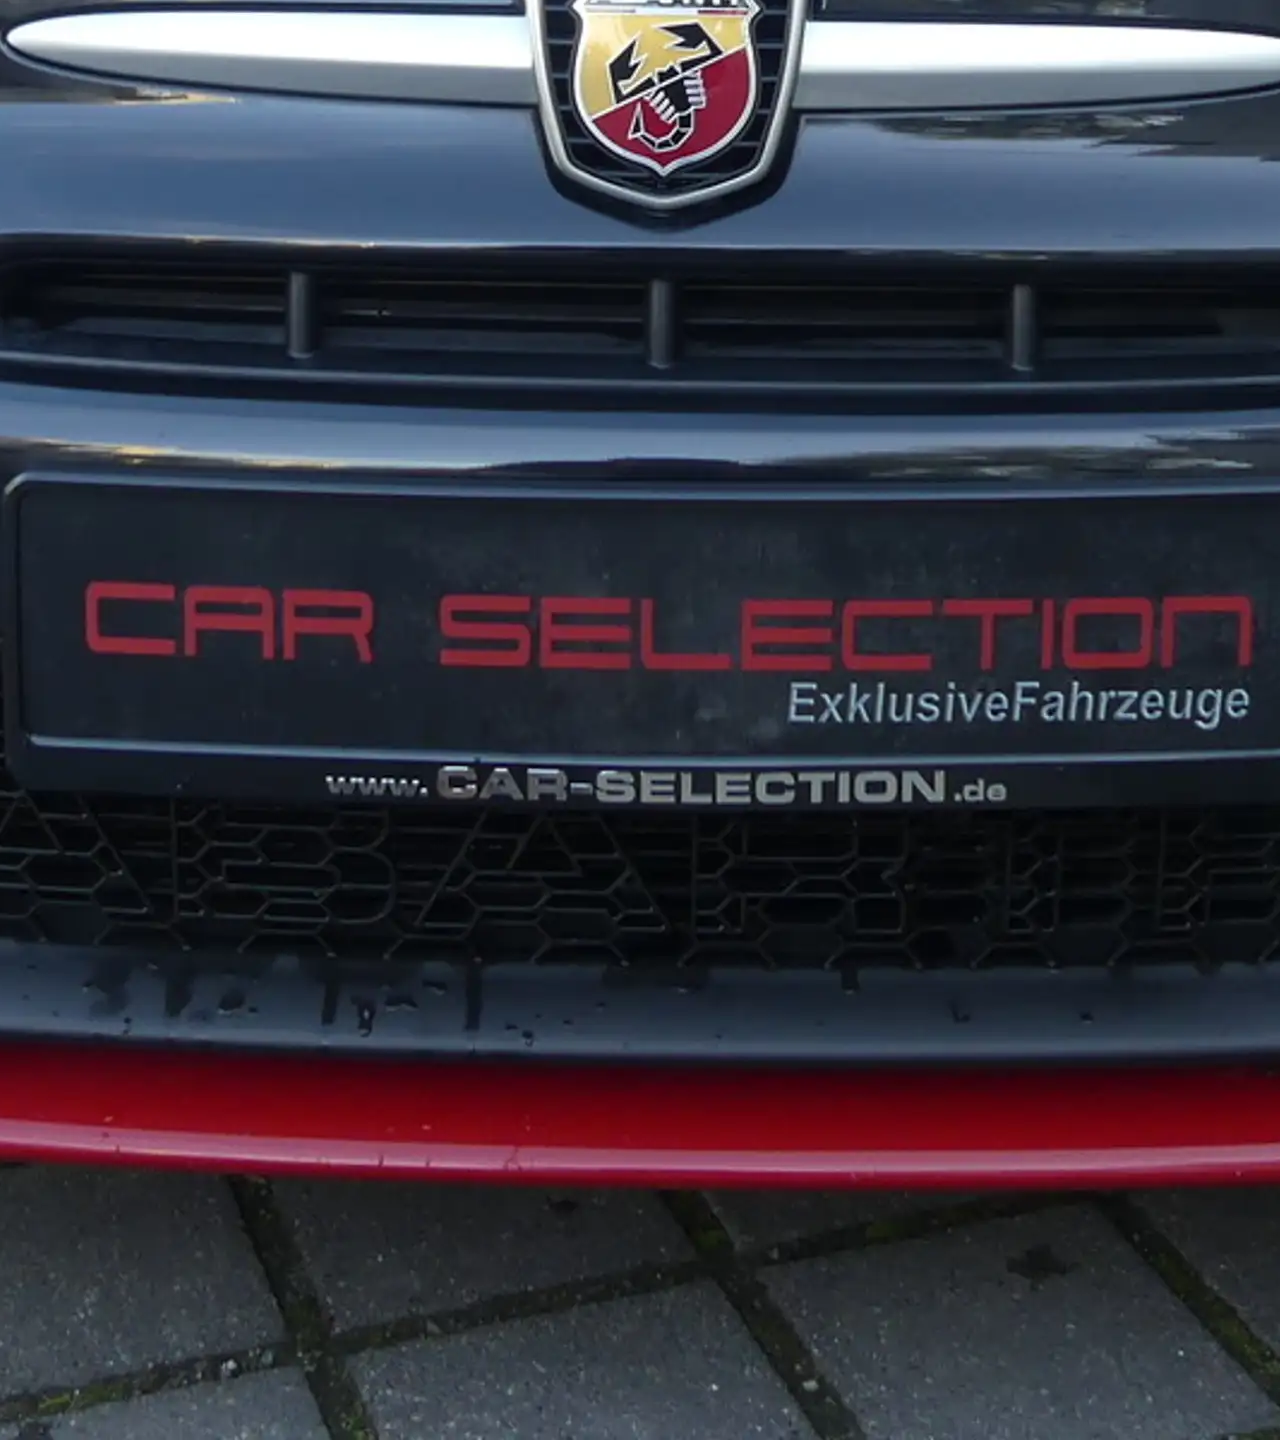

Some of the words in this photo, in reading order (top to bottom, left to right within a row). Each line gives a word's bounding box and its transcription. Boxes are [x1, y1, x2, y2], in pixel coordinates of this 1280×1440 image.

[85, 580, 374, 663] CAR
[439, 595, 1253, 671] SELECTION
[787, 680, 1251, 730] ExklusiveFahrzeuge
